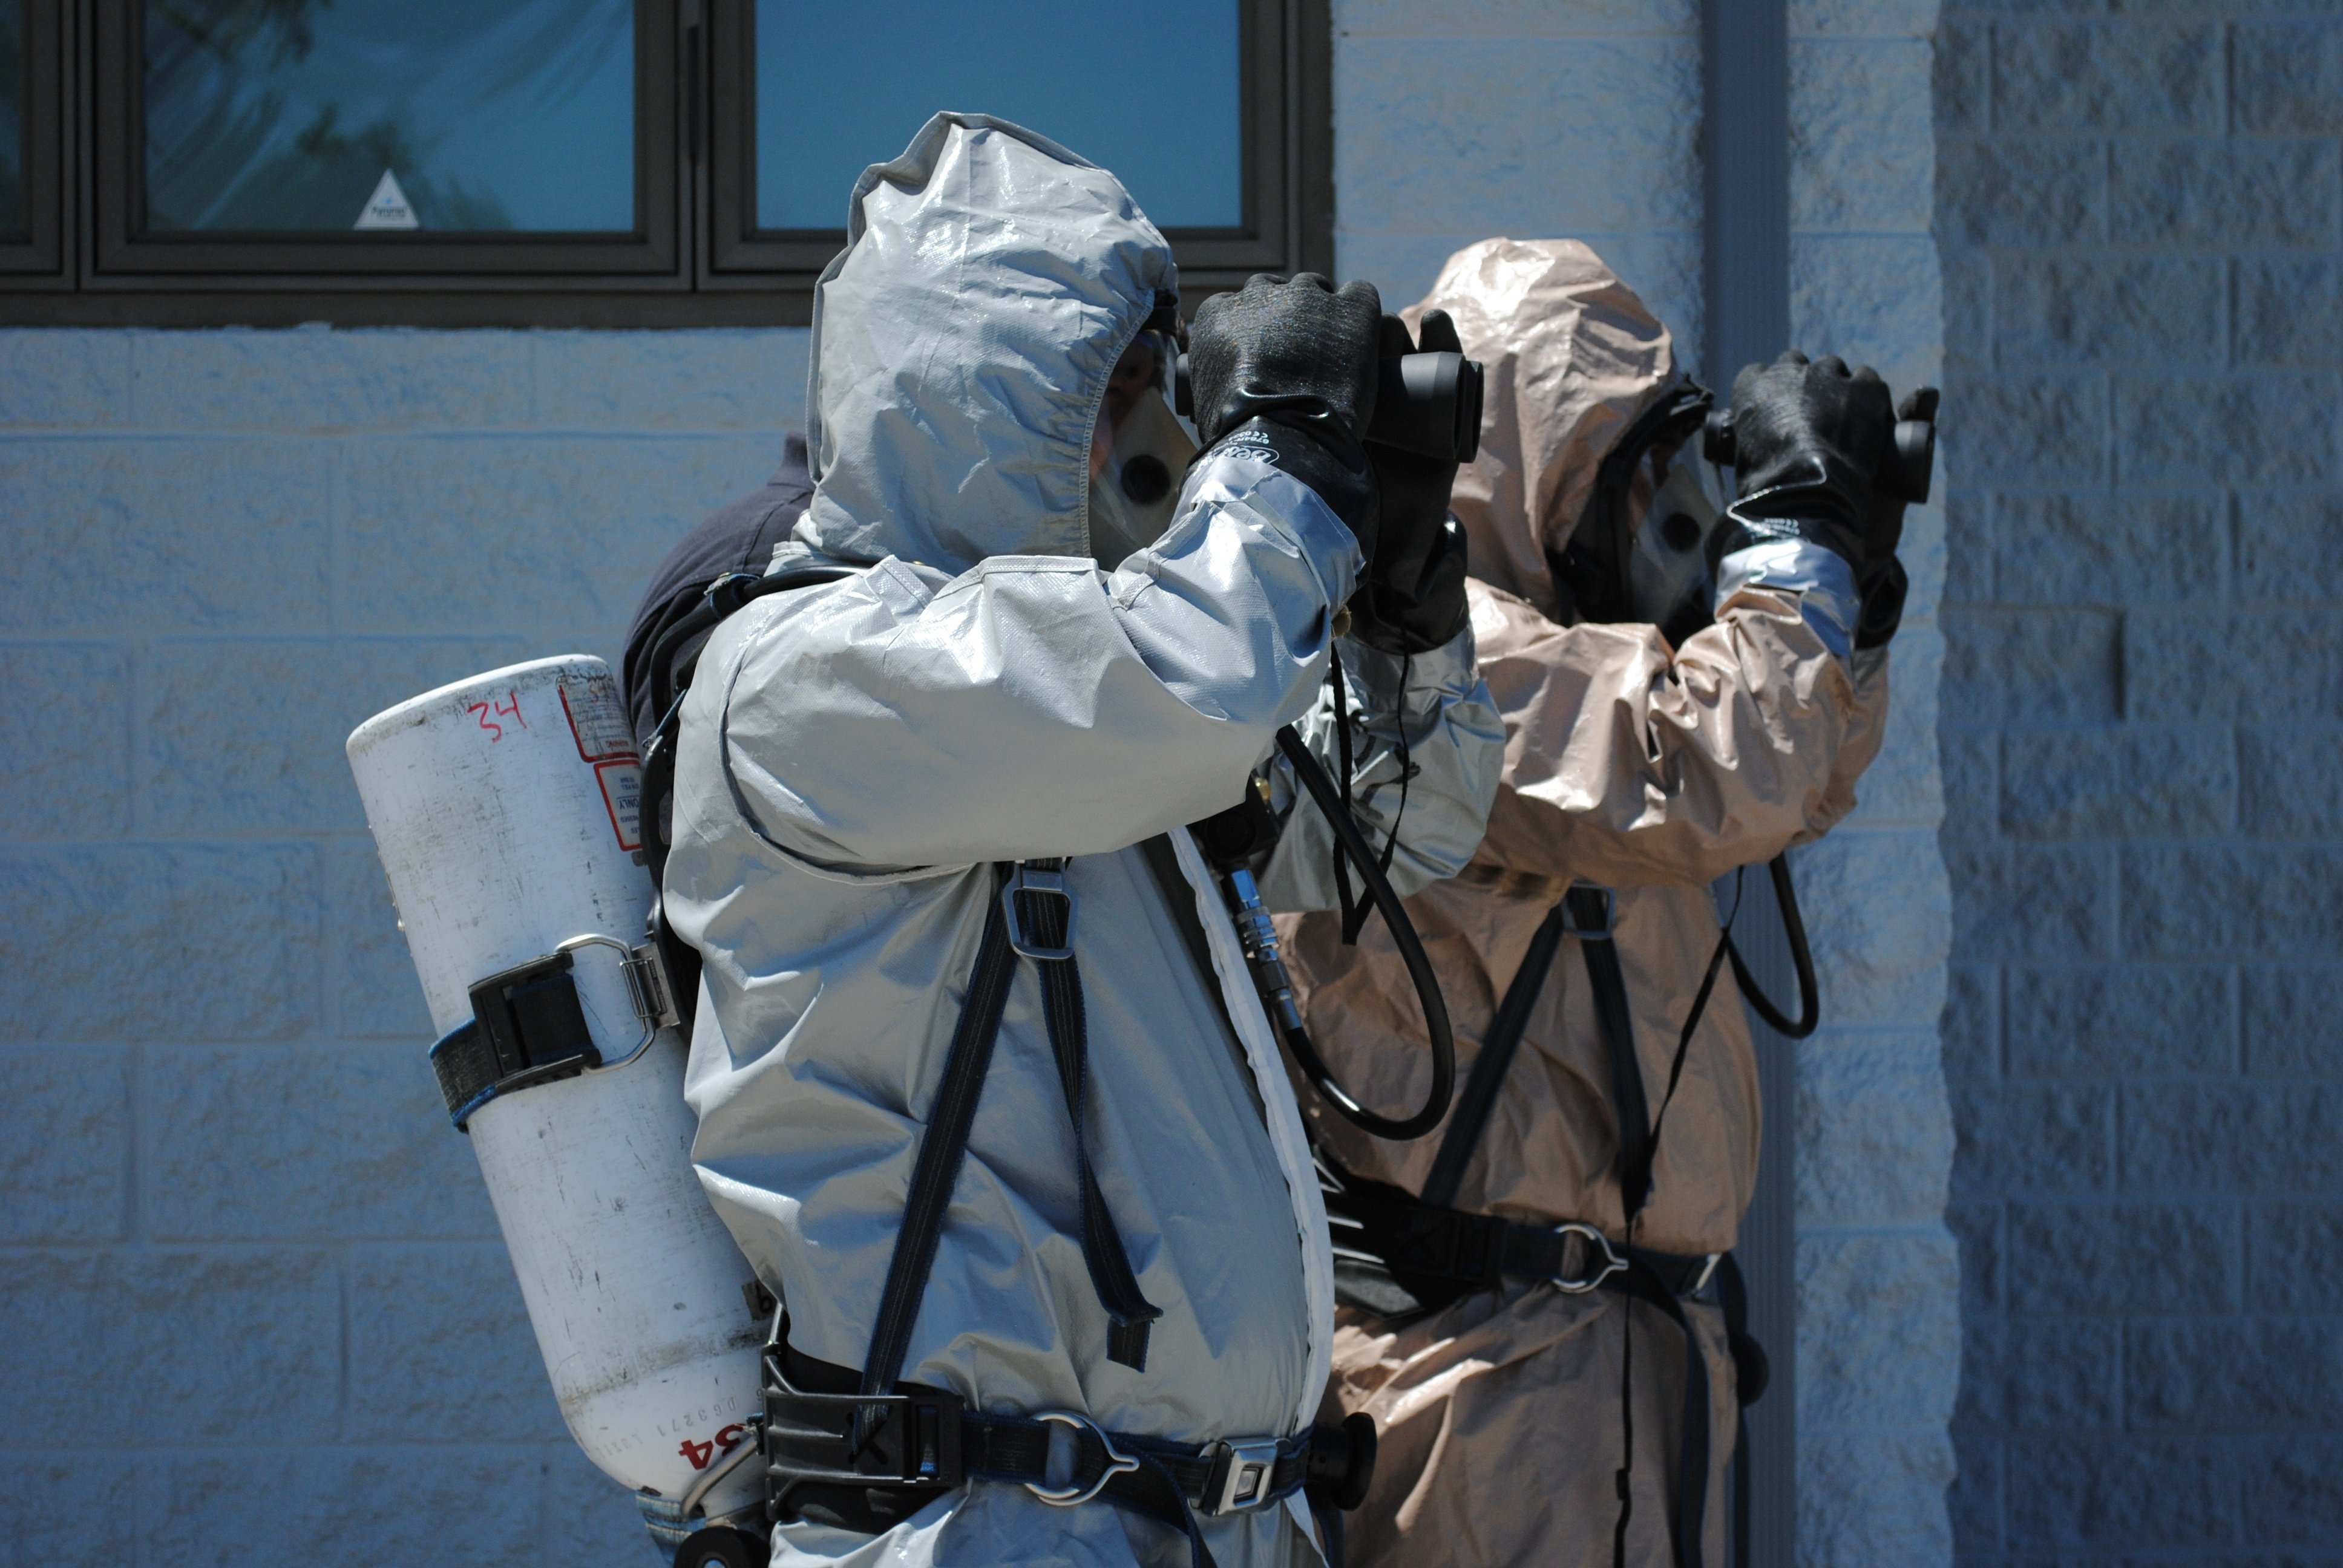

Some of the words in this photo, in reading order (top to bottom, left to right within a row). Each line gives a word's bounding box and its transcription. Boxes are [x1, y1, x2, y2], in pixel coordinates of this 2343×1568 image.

[467, 690, 527, 743] 34
[619, 797, 640, 810] ONLY
[678, 1423, 745, 1471] 34
